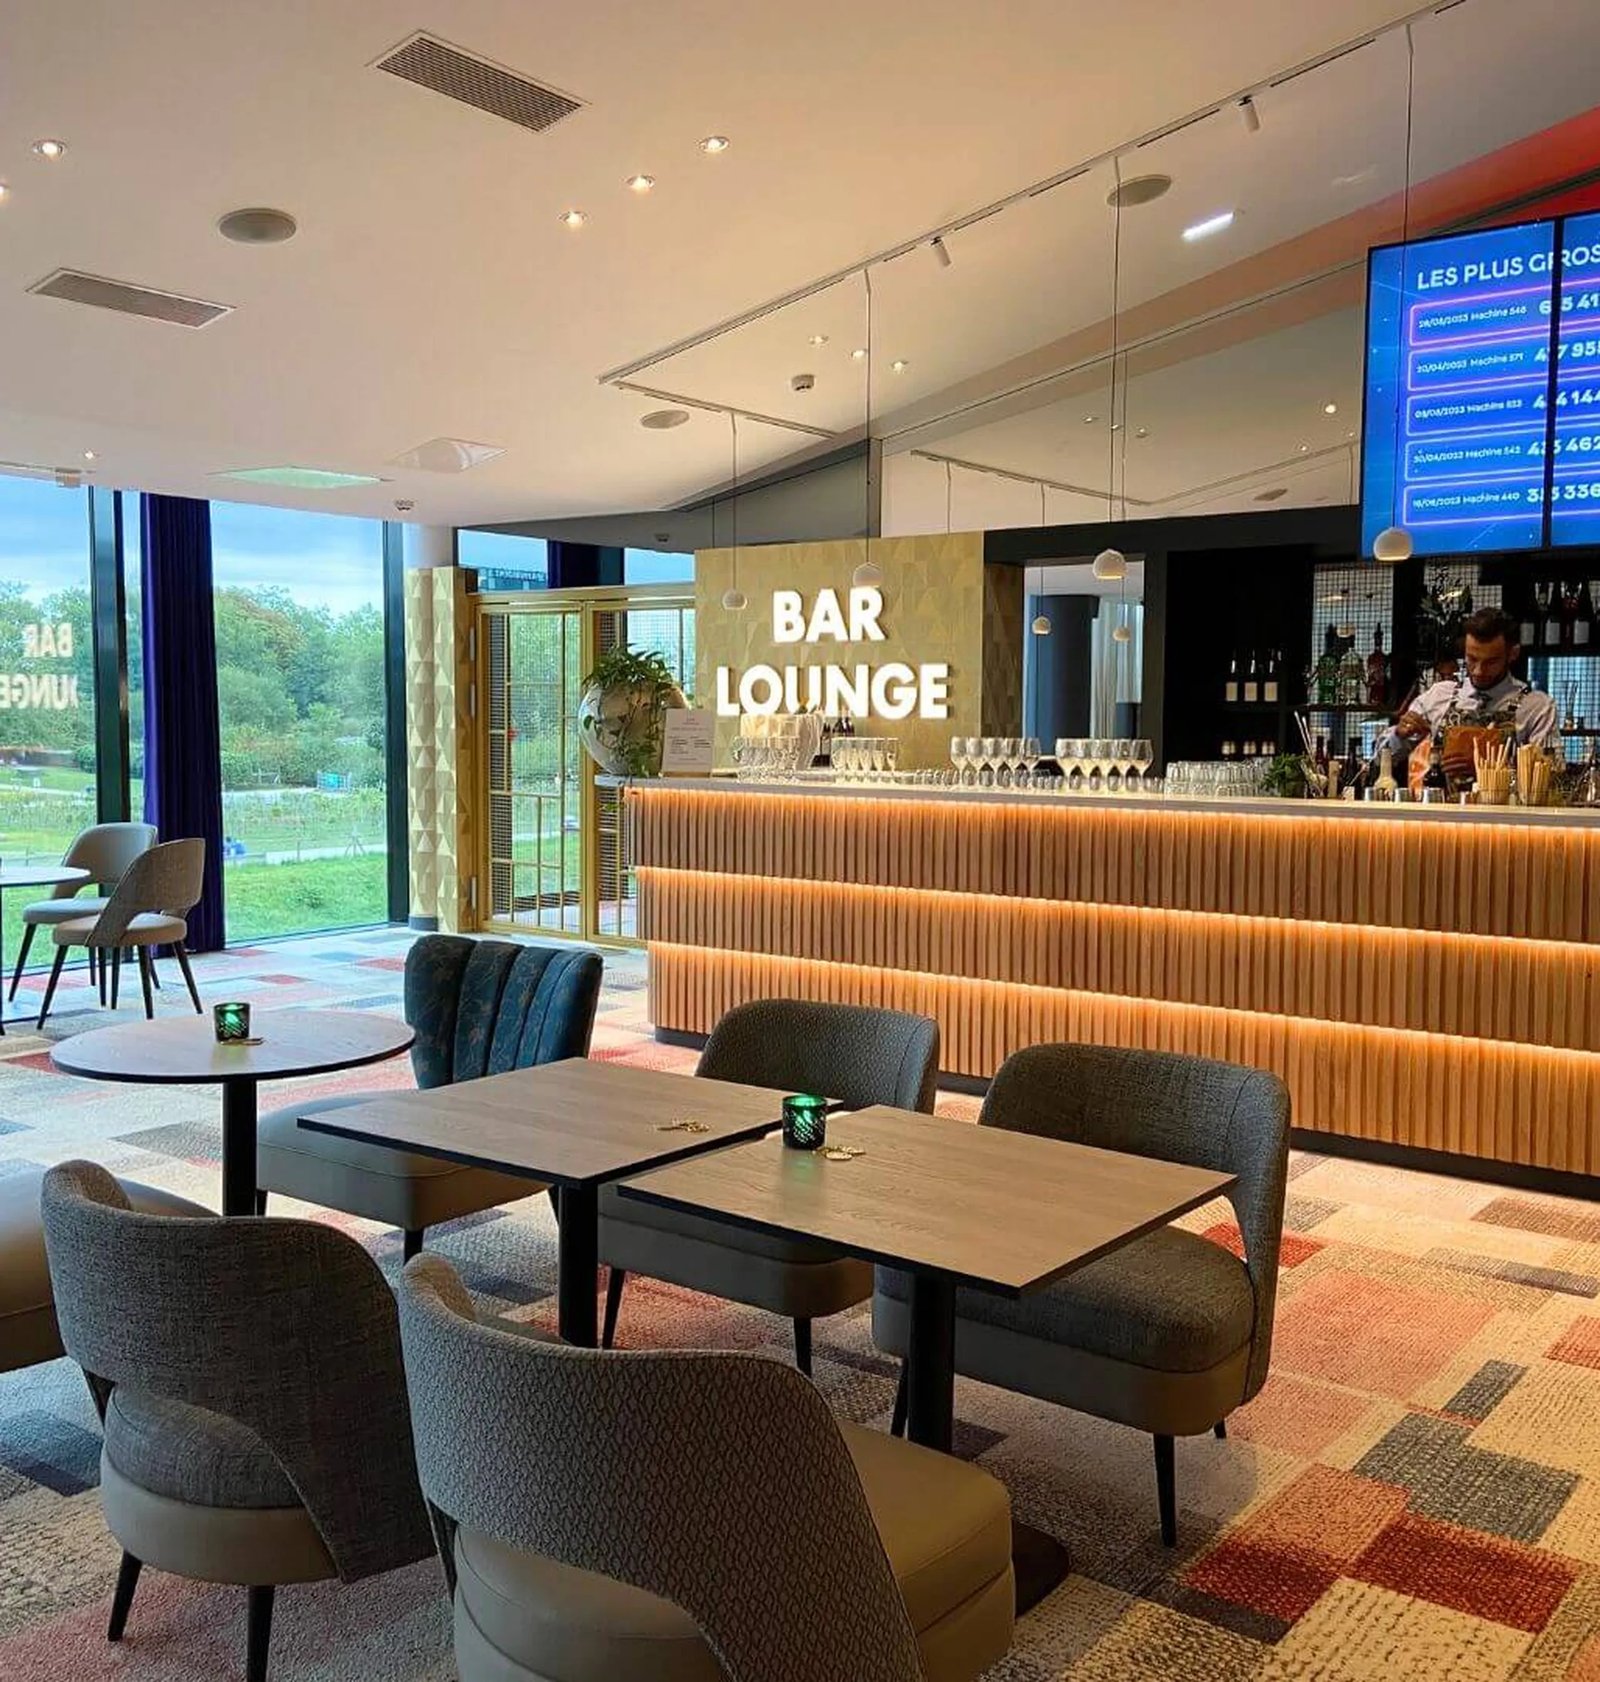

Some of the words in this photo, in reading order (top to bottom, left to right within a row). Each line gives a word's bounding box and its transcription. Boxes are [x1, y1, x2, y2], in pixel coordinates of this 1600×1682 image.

[1417, 267, 1458, 290] LES
[1463, 257, 1523, 283] PLUS
[1528, 244, 1600, 272] GROS
[1470, 308, 1508, 321] Machine
[1470, 355, 1508, 367] Machine
[1466, 401, 1504, 414] Machine
[1465, 448, 1503, 459] Machine
[1463, 491, 1500, 504] Machine
[773, 586, 886, 643] BAR
[716, 663, 948, 719] LOUNGE
